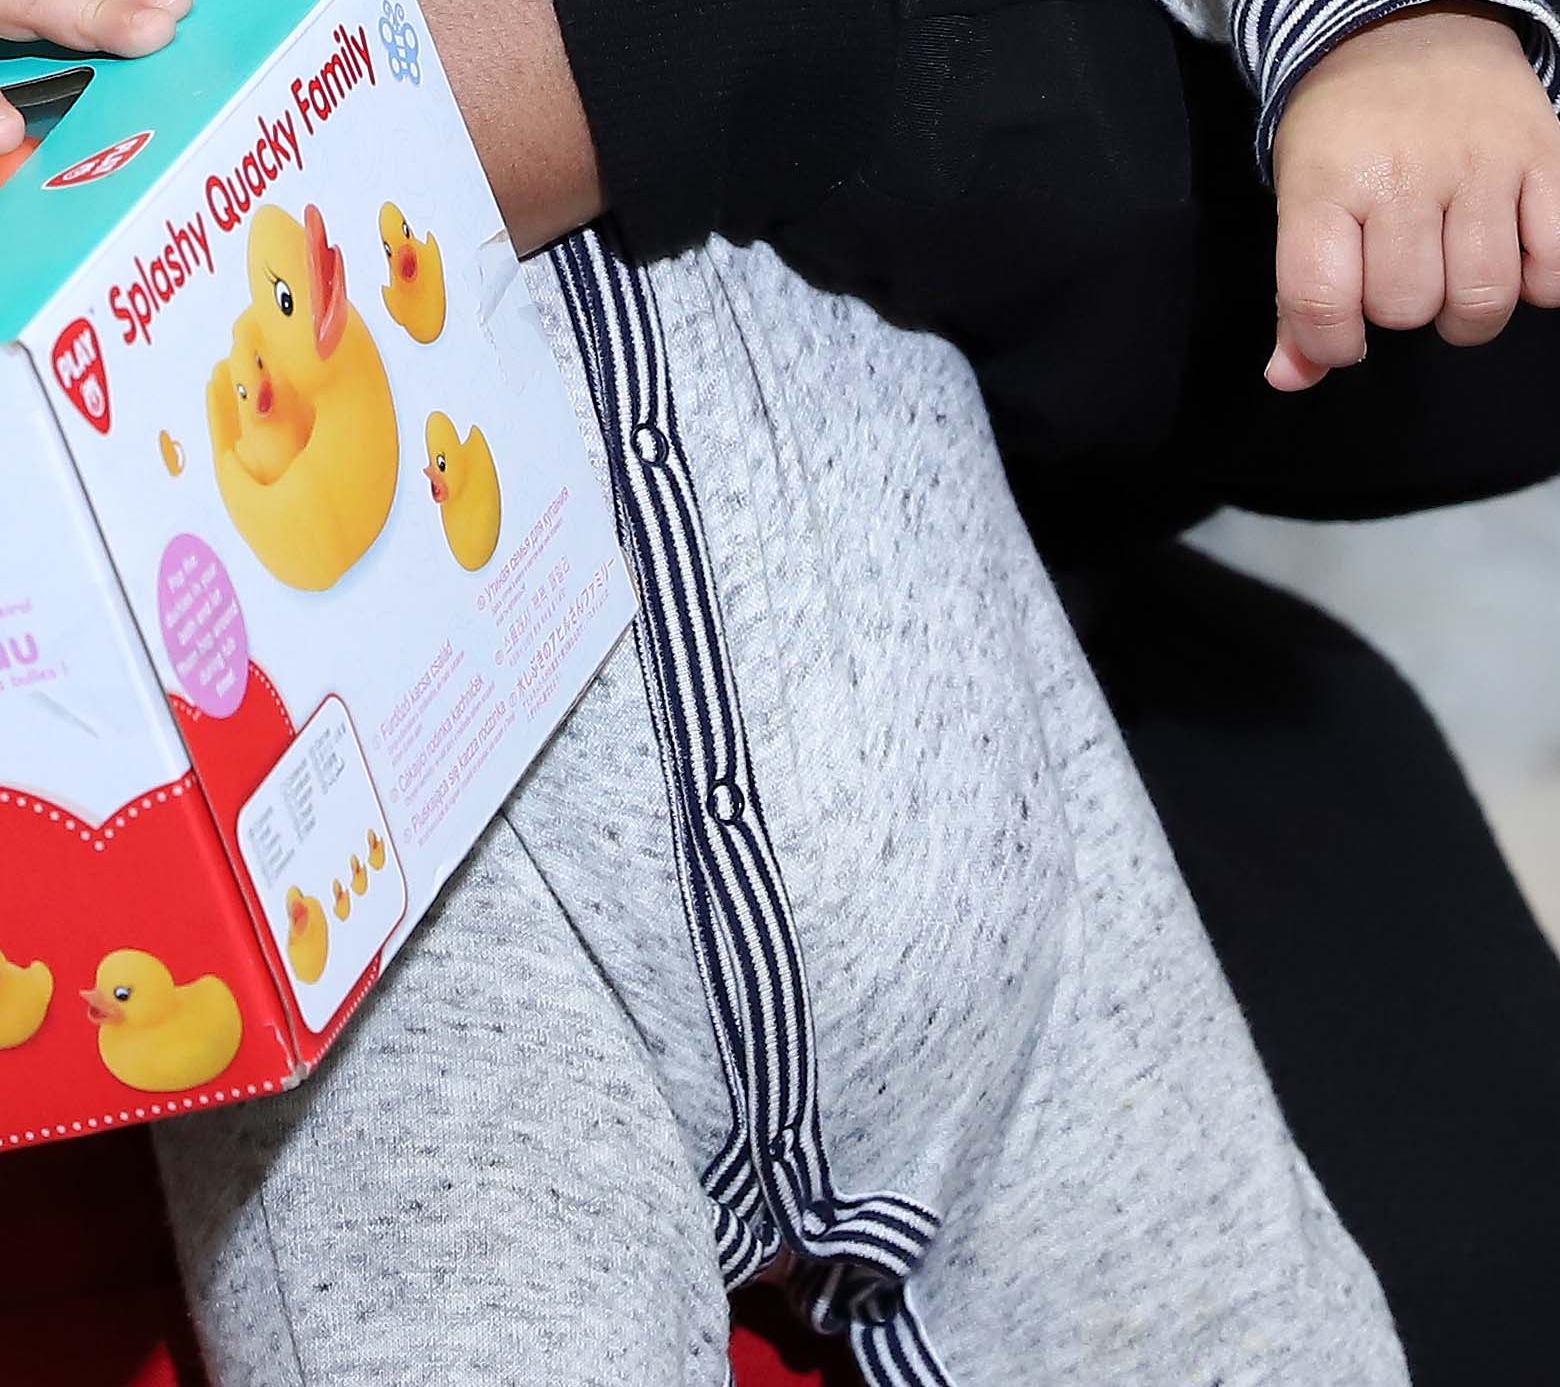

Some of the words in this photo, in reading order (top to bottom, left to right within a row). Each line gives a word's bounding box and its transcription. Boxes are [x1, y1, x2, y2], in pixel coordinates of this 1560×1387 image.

[109, 213, 214, 345] Splashy
[206, 110, 303, 232] Quacky
[291, 25, 375, 135] Family
[57, 330, 96, 387] PLAY
